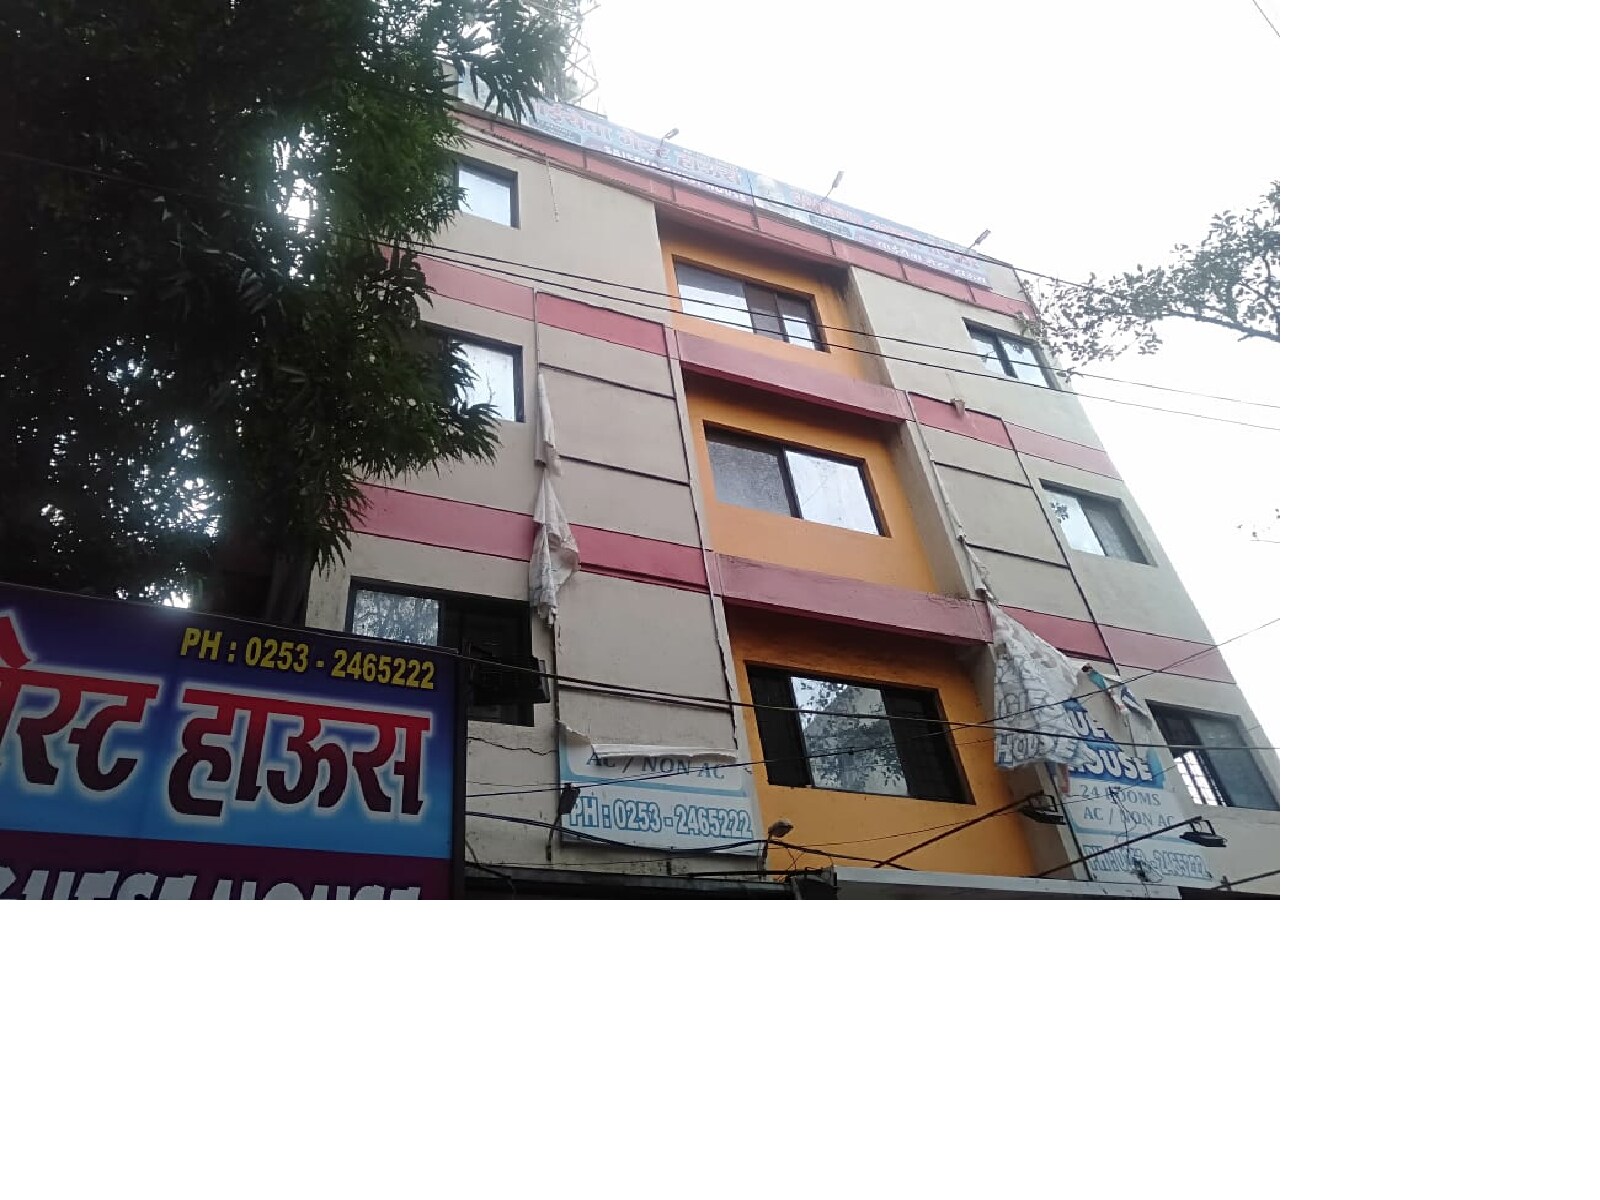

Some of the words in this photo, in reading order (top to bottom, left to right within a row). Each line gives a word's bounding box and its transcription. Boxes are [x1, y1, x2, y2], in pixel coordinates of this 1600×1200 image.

[181, 628, 223, 661] PH
[245, 637, 309, 673] 0253
[331, 650, 435, 690] 2465222
[168, 688, 430, 816] हाऊस
[641, 756, 690, 776] NON
[698, 763, 725, 780] AC
[1080, 784, 1101, 799] 24
[570, 796, 599, 828] PH
[613, 798, 662, 833] 0253
[674, 802, 753, 840] 2465222
[1083, 806, 1104, 821] AC
